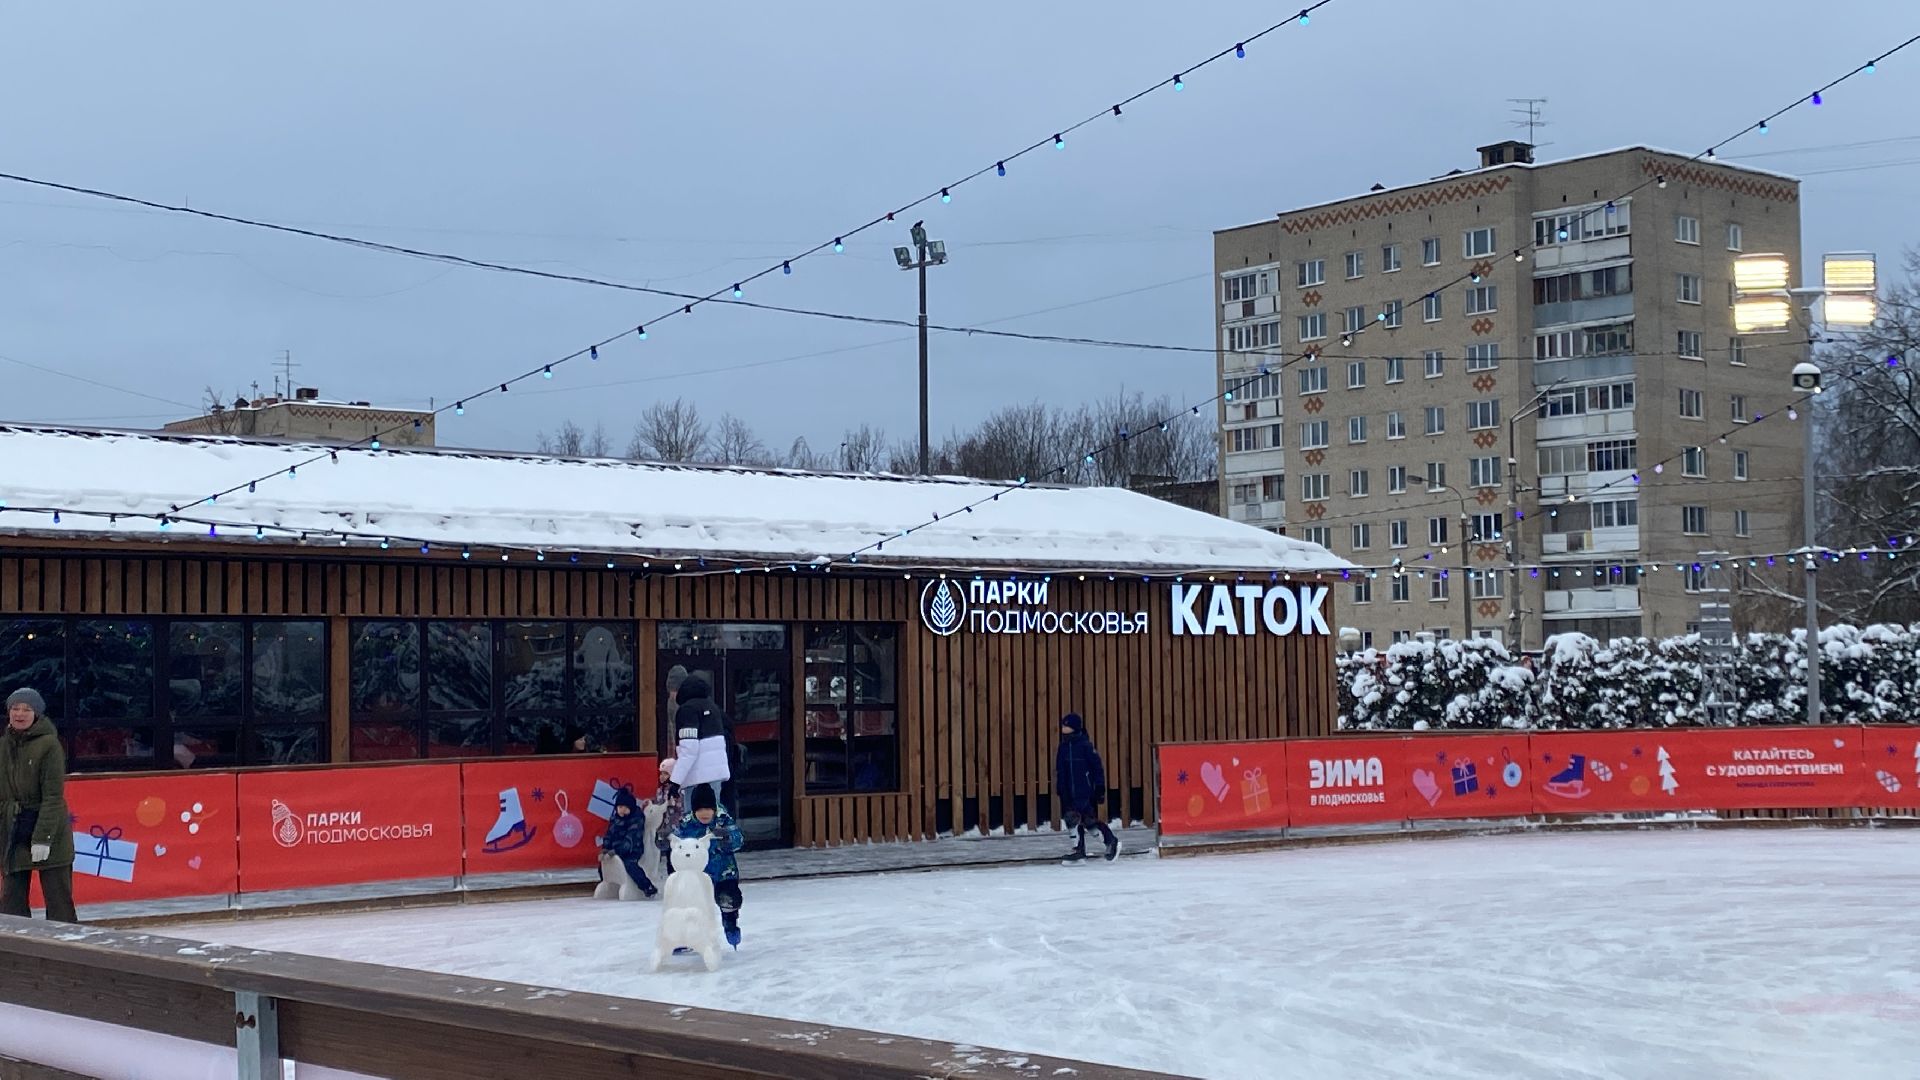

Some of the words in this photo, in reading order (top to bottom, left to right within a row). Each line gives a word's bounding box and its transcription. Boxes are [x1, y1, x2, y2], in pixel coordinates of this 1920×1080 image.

[970, 580, 1048, 605] ПАРКИ
[1172, 583, 1330, 637] КАТОК
[970, 609, 1149, 634] ПОДМОСКОВЬЯ
[1734, 747, 1815, 761] КАТАЙТЕСЬ
[1309, 757, 1384, 789] ЗИМА
[1706, 765, 1716, 777] С
[1718, 763, 1844, 778] УДОВОЛЬСТВИЕМ!
[1311, 794, 1318, 806] В
[1319, 792, 1386, 807] ПОДМОСКОВЬЕ
[308, 811, 361, 827] ПАРКИ
[308, 823, 434, 844] ПОДМОСКОВЬЯ
